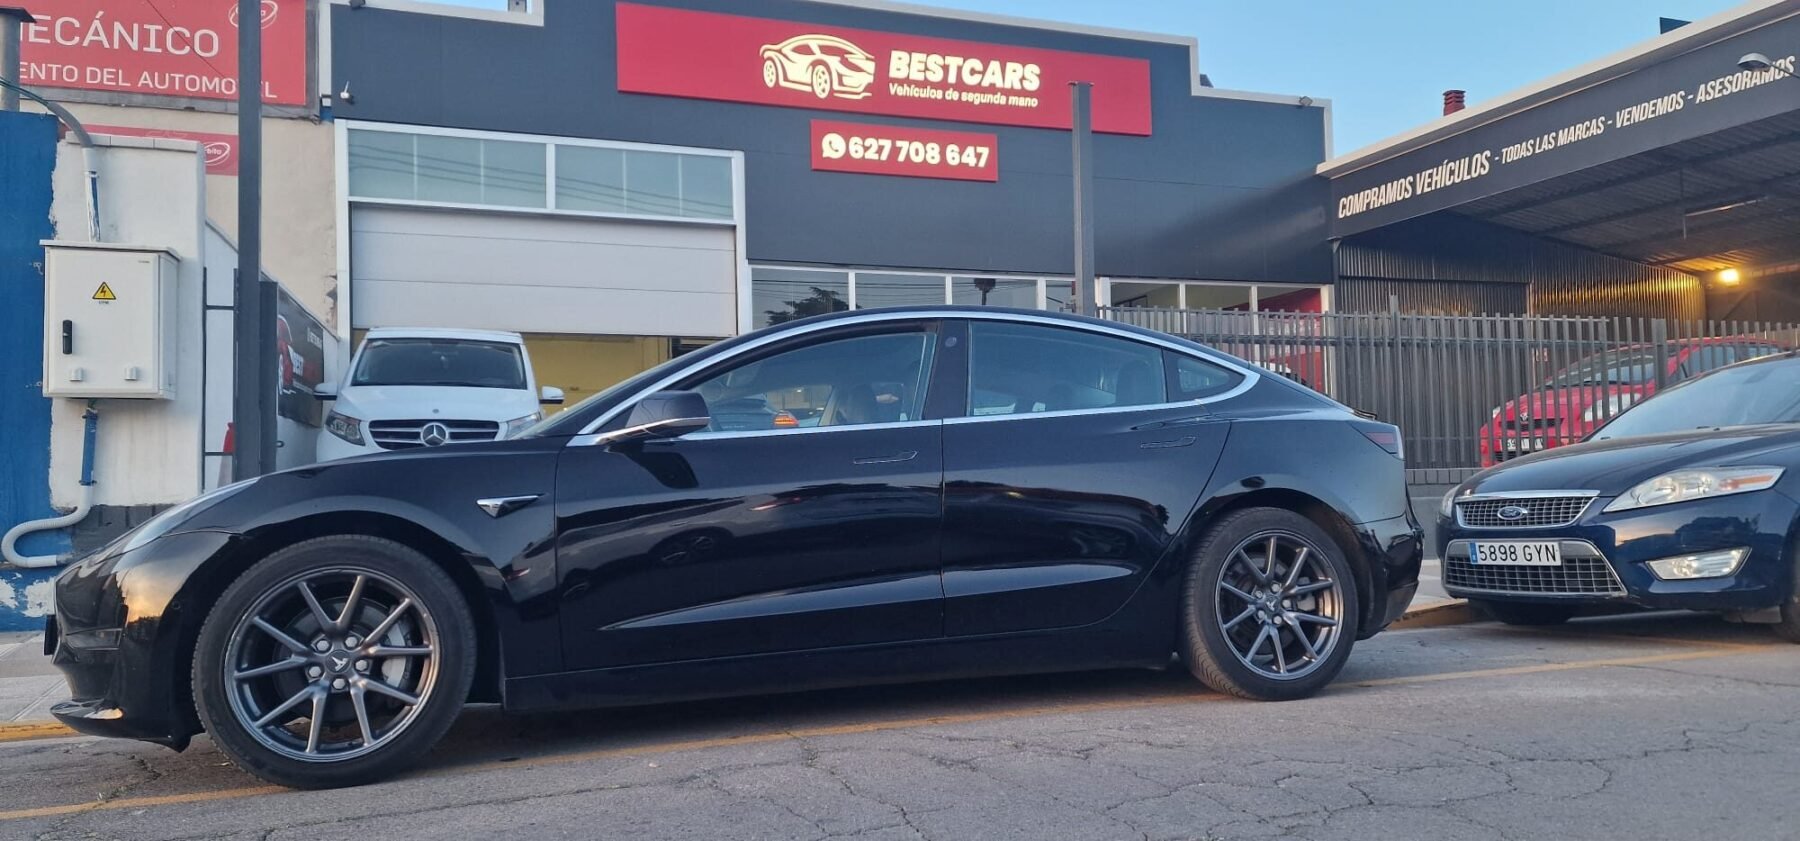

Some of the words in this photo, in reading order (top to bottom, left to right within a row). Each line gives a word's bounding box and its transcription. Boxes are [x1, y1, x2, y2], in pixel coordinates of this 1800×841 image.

[86, 67, 131, 87] DEL
[138, 71, 278, 99] AUTOMOL
[889, 50, 1041, 91] BESTCARS
[889, 83, 943, 100] Vehículos
[945, 88, 960, 101] de
[961, 91, 1007, 105] segunda
[1008, 95, 1039, 108] mano
[848, 136, 892, 161] 627
[895, 140, 941, 165] 708
[945, 144, 990, 168] 647
[1338, 176, 1413, 218] COMPRAMOS
[1416, 150, 1491, 195] VEHÍCULOS
[1501, 138, 1533, 165] TODAS
[1535, 132, 1555, 154] LAS
[1557, 116, 1605, 147] MARCAS
[1615, 90, 1685, 129] VENDEMOS
[1696, 55, 1796, 104] ASESORAMOS
[1478, 545, 1518, 561] 5898
[1522, 544, 1556, 562] GYN
